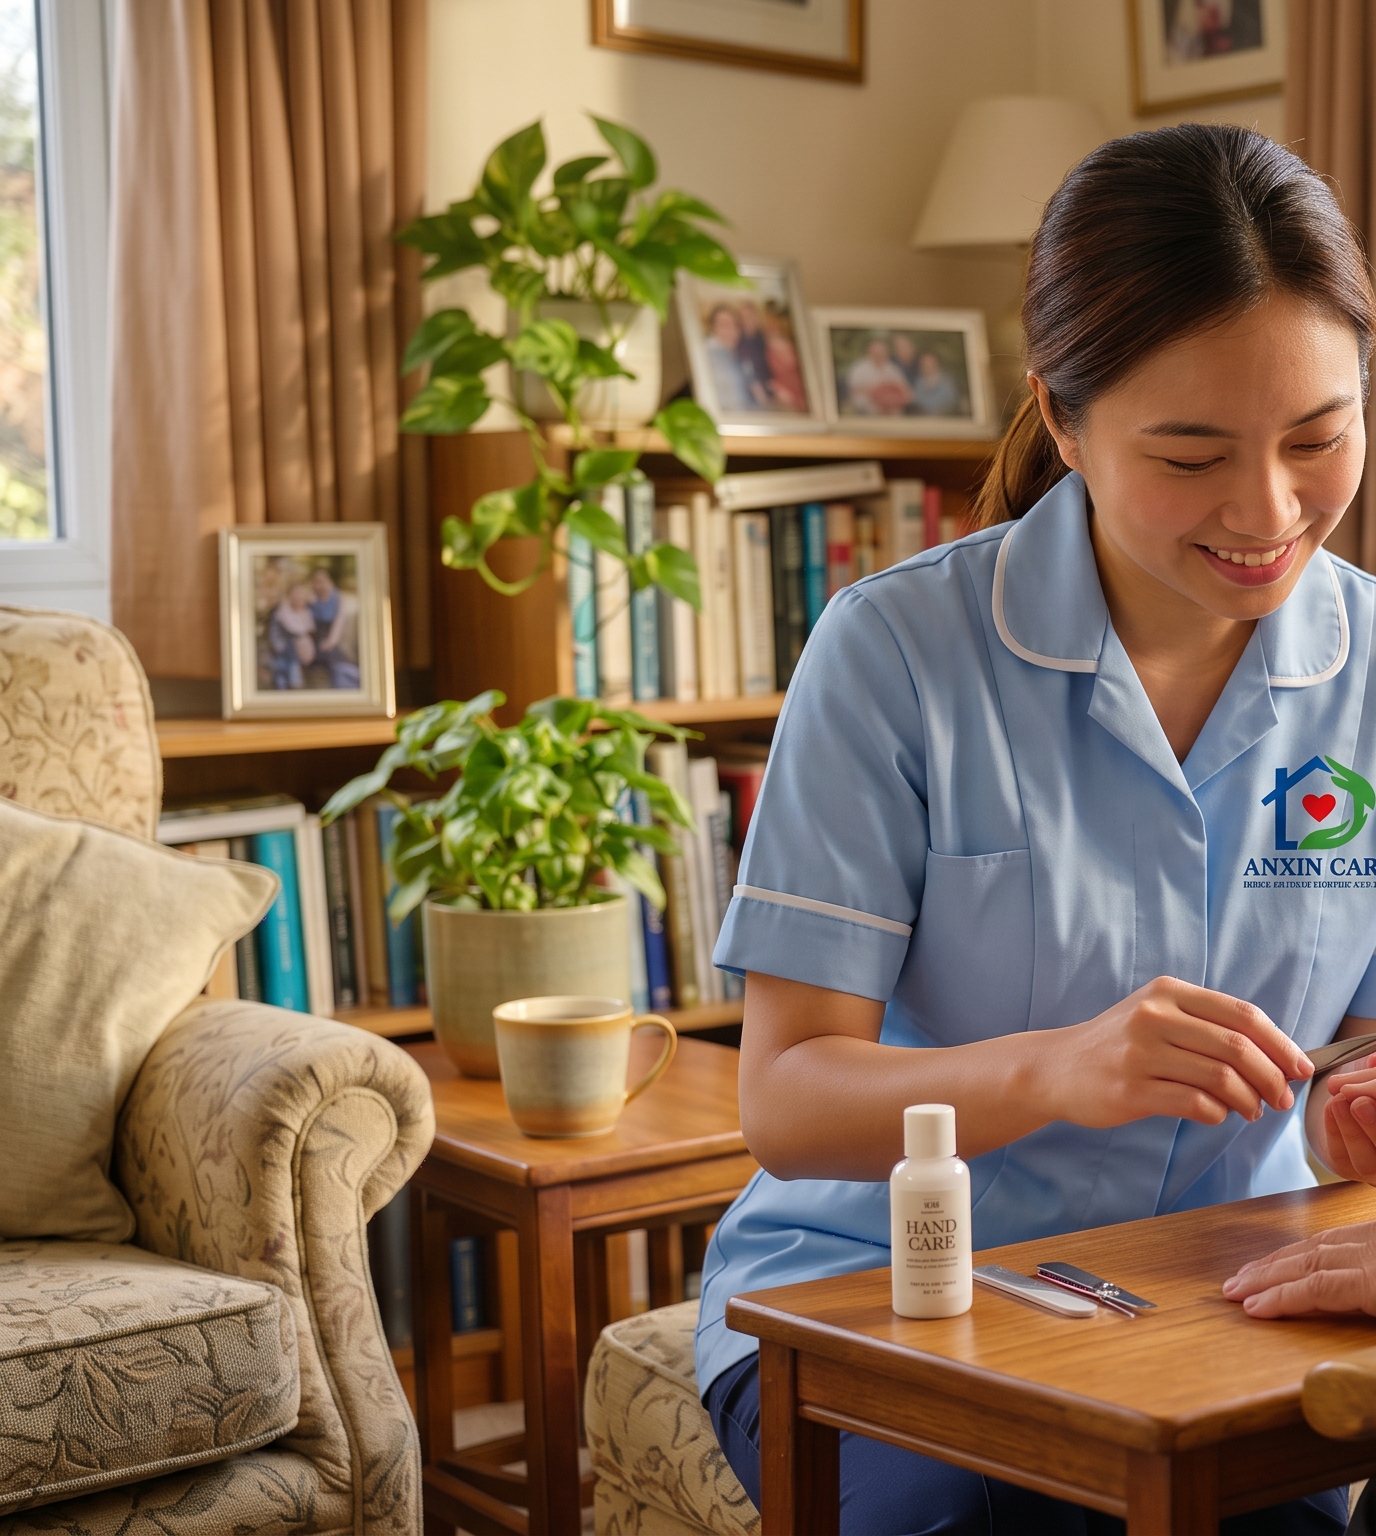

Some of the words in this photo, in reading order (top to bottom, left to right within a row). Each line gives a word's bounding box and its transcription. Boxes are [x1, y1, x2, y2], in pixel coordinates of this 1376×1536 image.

[1243, 857, 1323, 876] ANXIN
[906, 1219, 957, 1235] HAND
[908, 1235, 956, 1251] CARE
